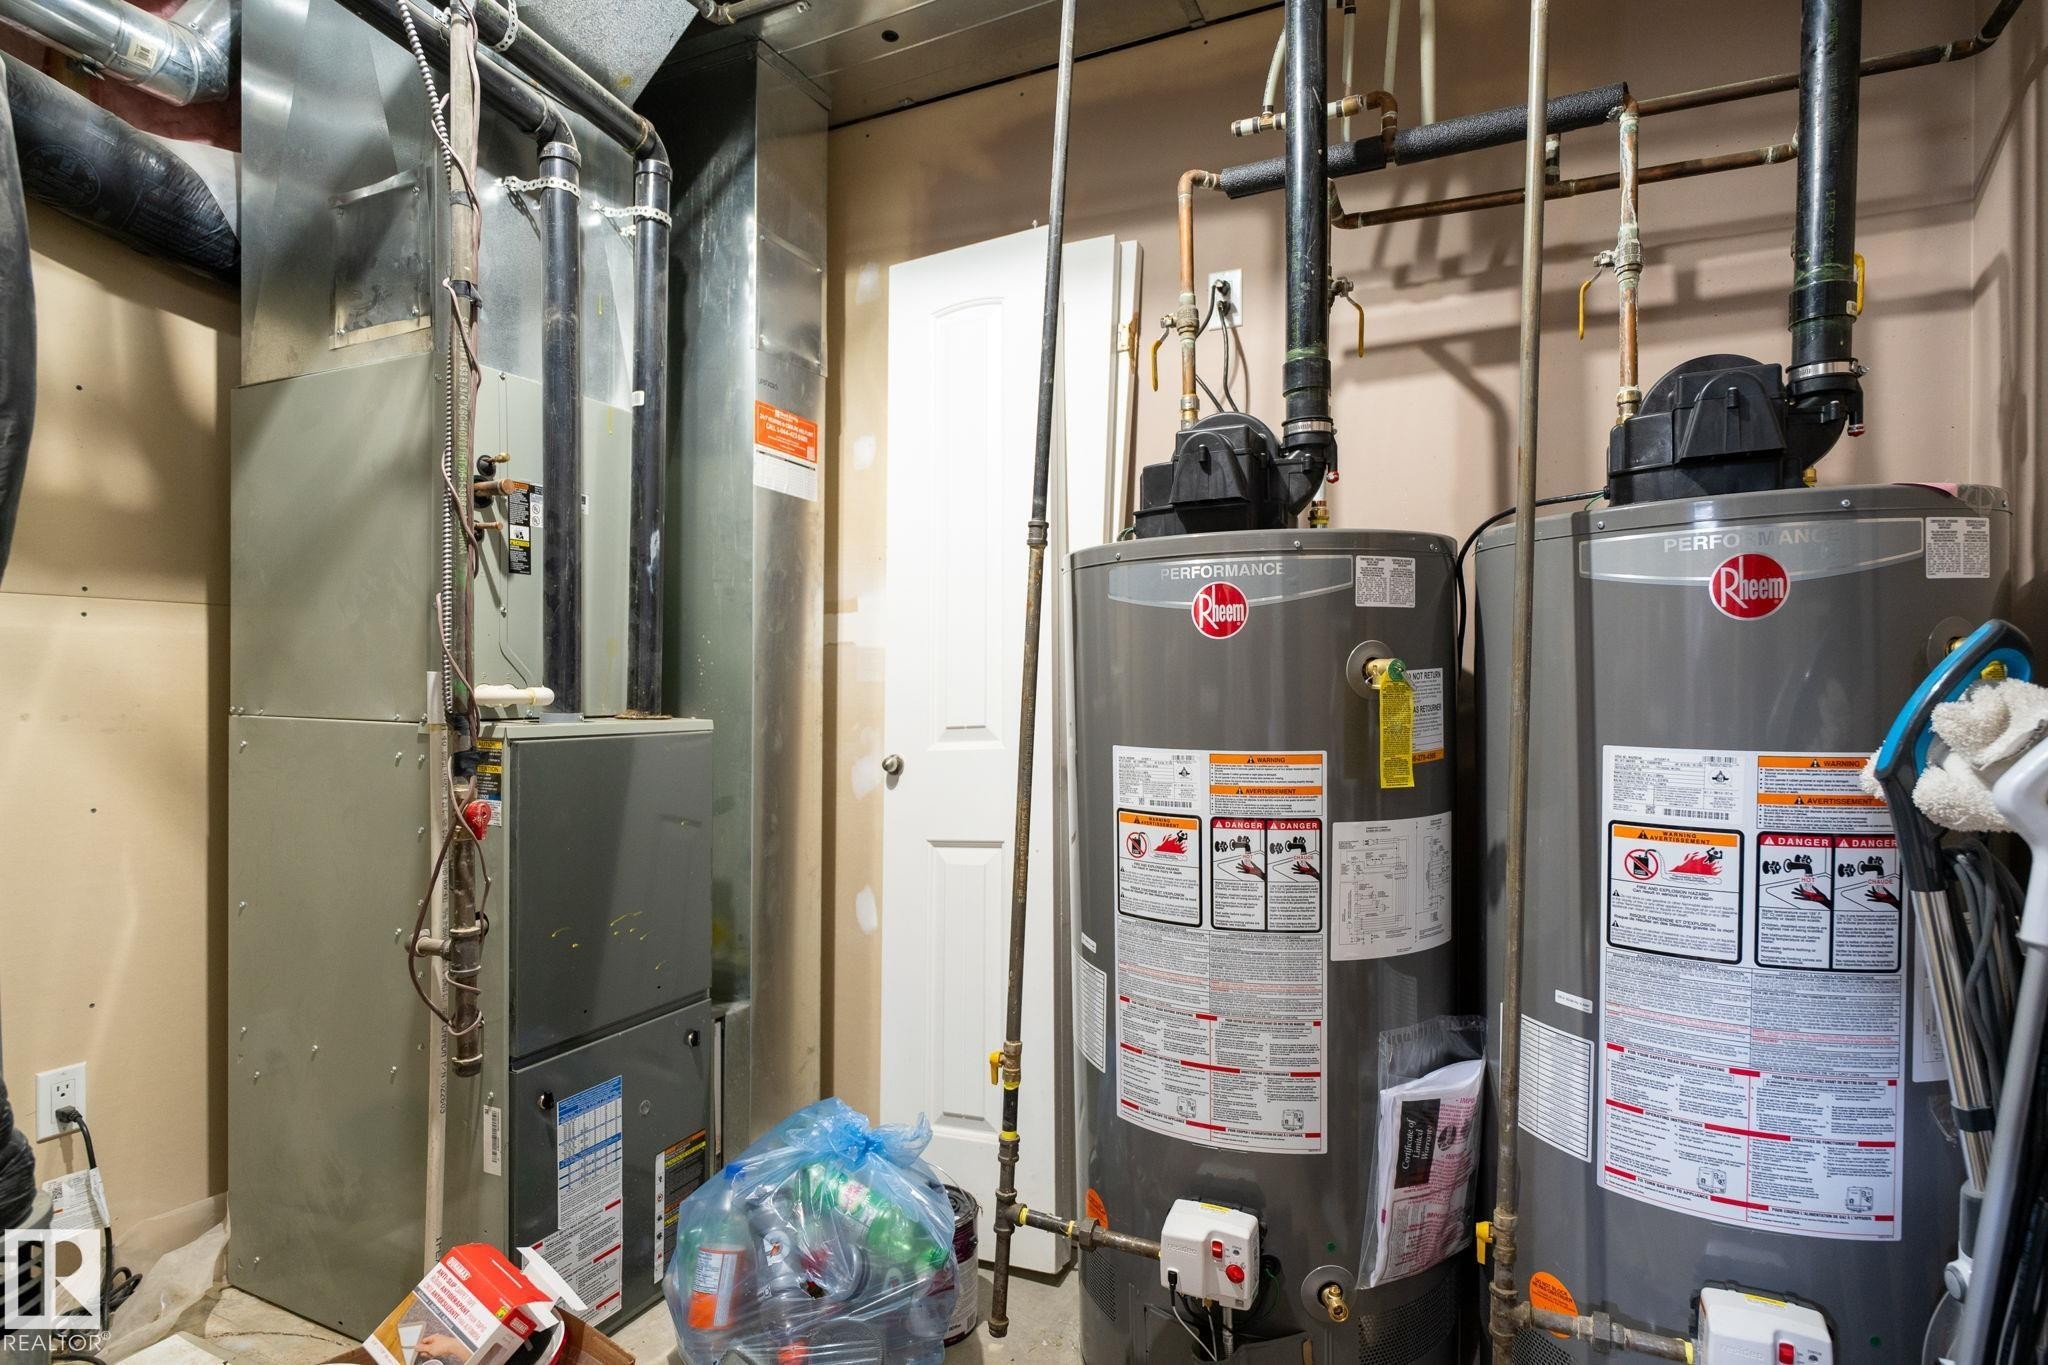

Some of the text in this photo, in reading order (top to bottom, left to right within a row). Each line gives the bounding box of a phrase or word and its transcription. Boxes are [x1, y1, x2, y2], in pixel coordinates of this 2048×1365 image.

[1160, 561, 1286, 581] PERFORMANCE
[1719, 555, 1785, 609] Rheem
[1197, 583, 1245, 631] Rheem
[1423, 670, 1442, 679] RETURN
[1823, 760, 1860, 768] WARNING
[1245, 787, 1296, 795] AVERTISSEMENT
[1807, 797, 1872, 805] AVERTISSEMENT
[1148, 815, 1171, 823] WARNING
[1225, 821, 1263, 829] DANGER
[1280, 822, 1318, 830] DANGER
[1662, 831, 1697, 839] WARNING
[1649, 835, 1711, 845] AVERTISSEMENT
[1777, 837, 1829, 847] DANGER
[1645, 1111, 1703, 1127] OPERATING INSTRUCTIONS
[1401, 1118, 1416, 1170] Certificate of
[1412, 1128, 1424, 1158] Limited
